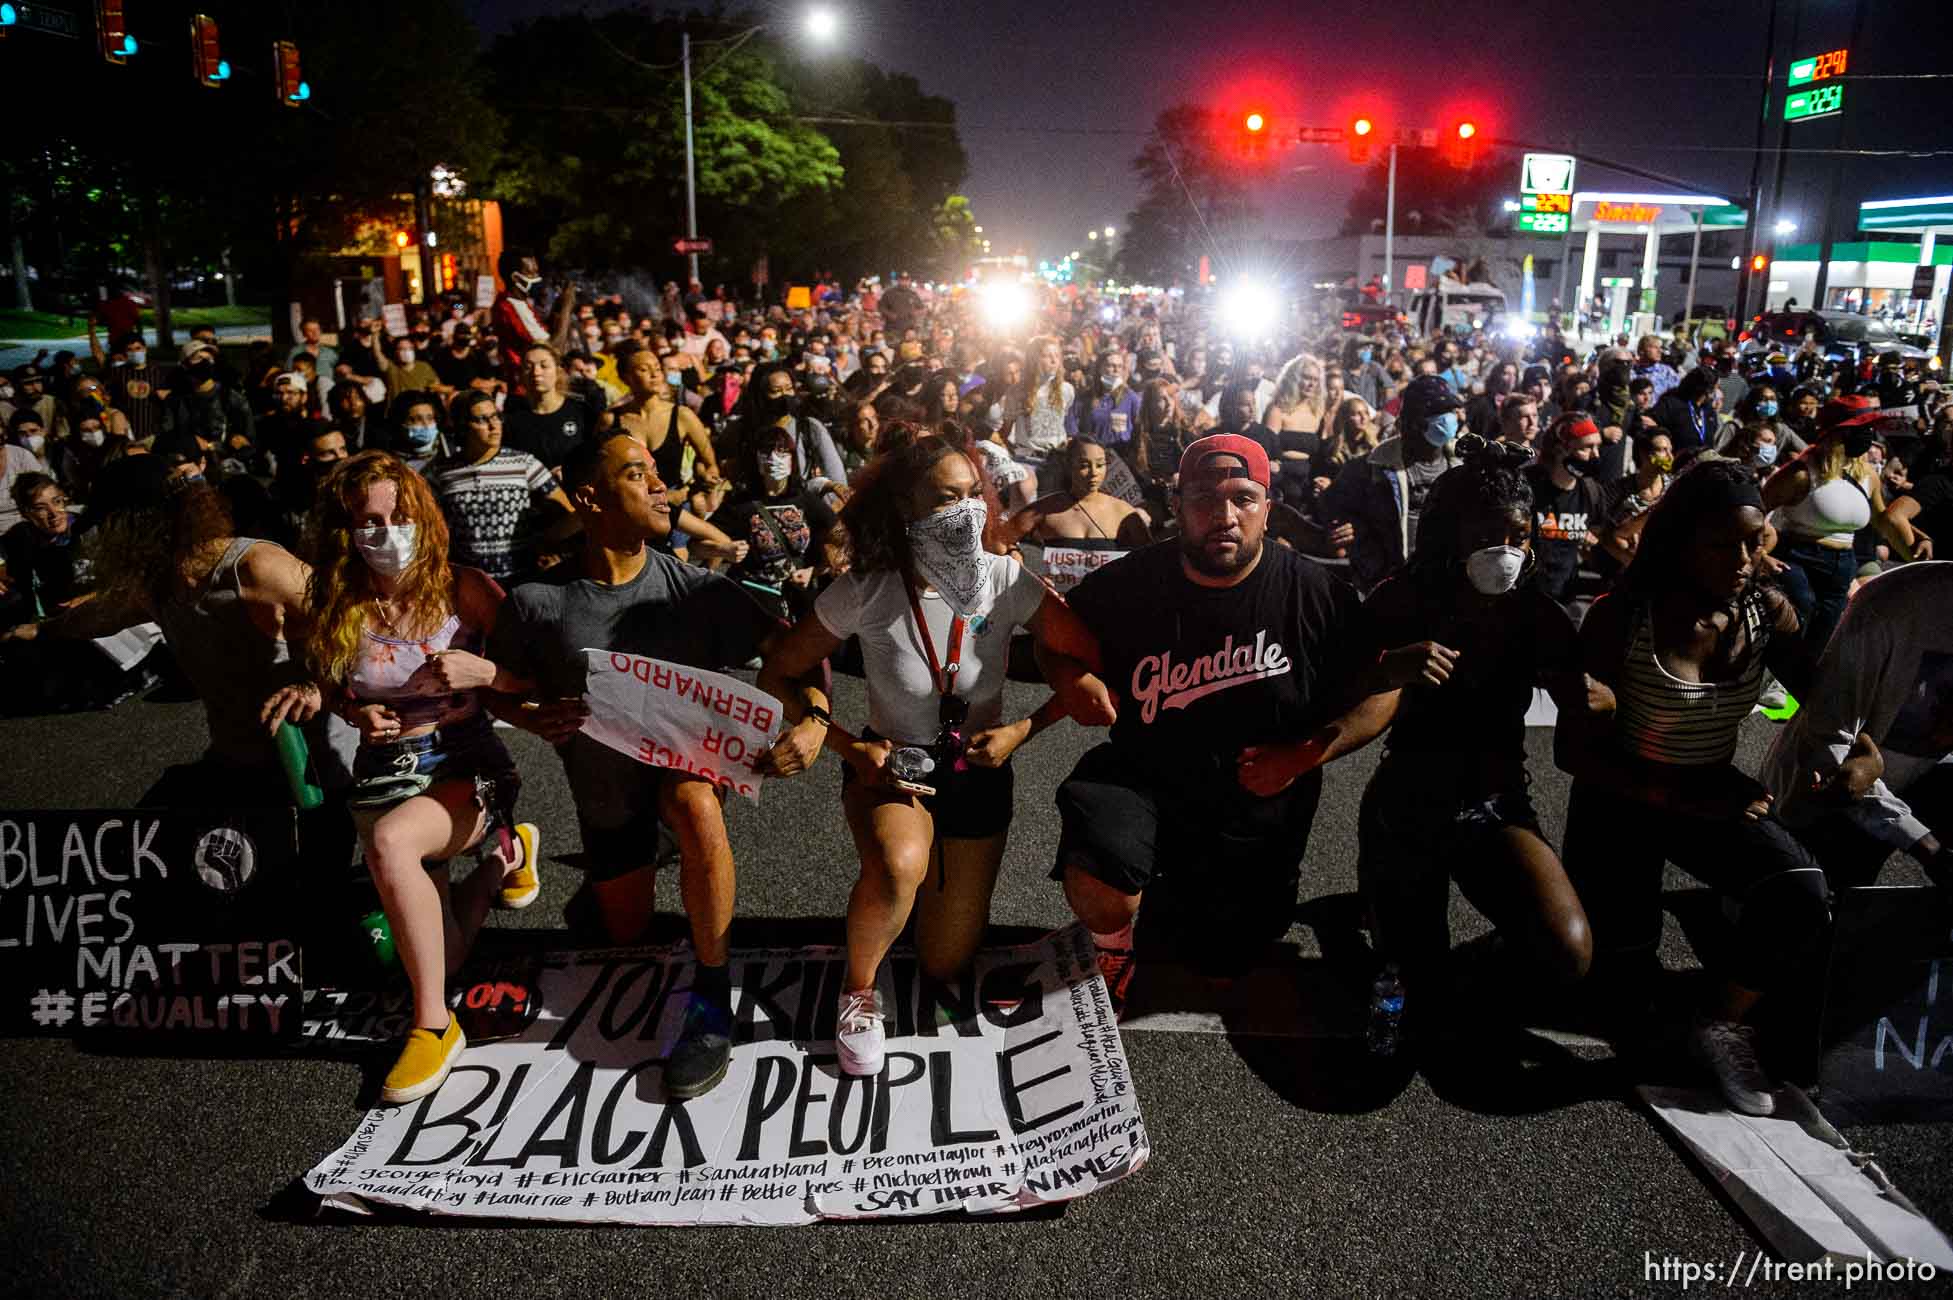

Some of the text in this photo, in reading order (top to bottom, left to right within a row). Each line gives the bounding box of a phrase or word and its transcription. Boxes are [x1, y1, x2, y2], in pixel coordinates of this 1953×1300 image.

[1046, 553, 1109, 567] JUSTICE
[610, 653, 774, 733] BERNARDO
[1131, 629, 1292, 724] Glendale
[703, 726, 763, 769] FOR
[0, 819, 168, 889] BLACK
[77, 939, 302, 989] MATTER
[30, 989, 289, 1035] #EQUALITY
[738, 957, 1043, 1043] KILING
[737, 1030, 1085, 1160] PEOPLE
[854, 1187, 923, 1212] SAY
[930, 1182, 1010, 1204] THEIR
